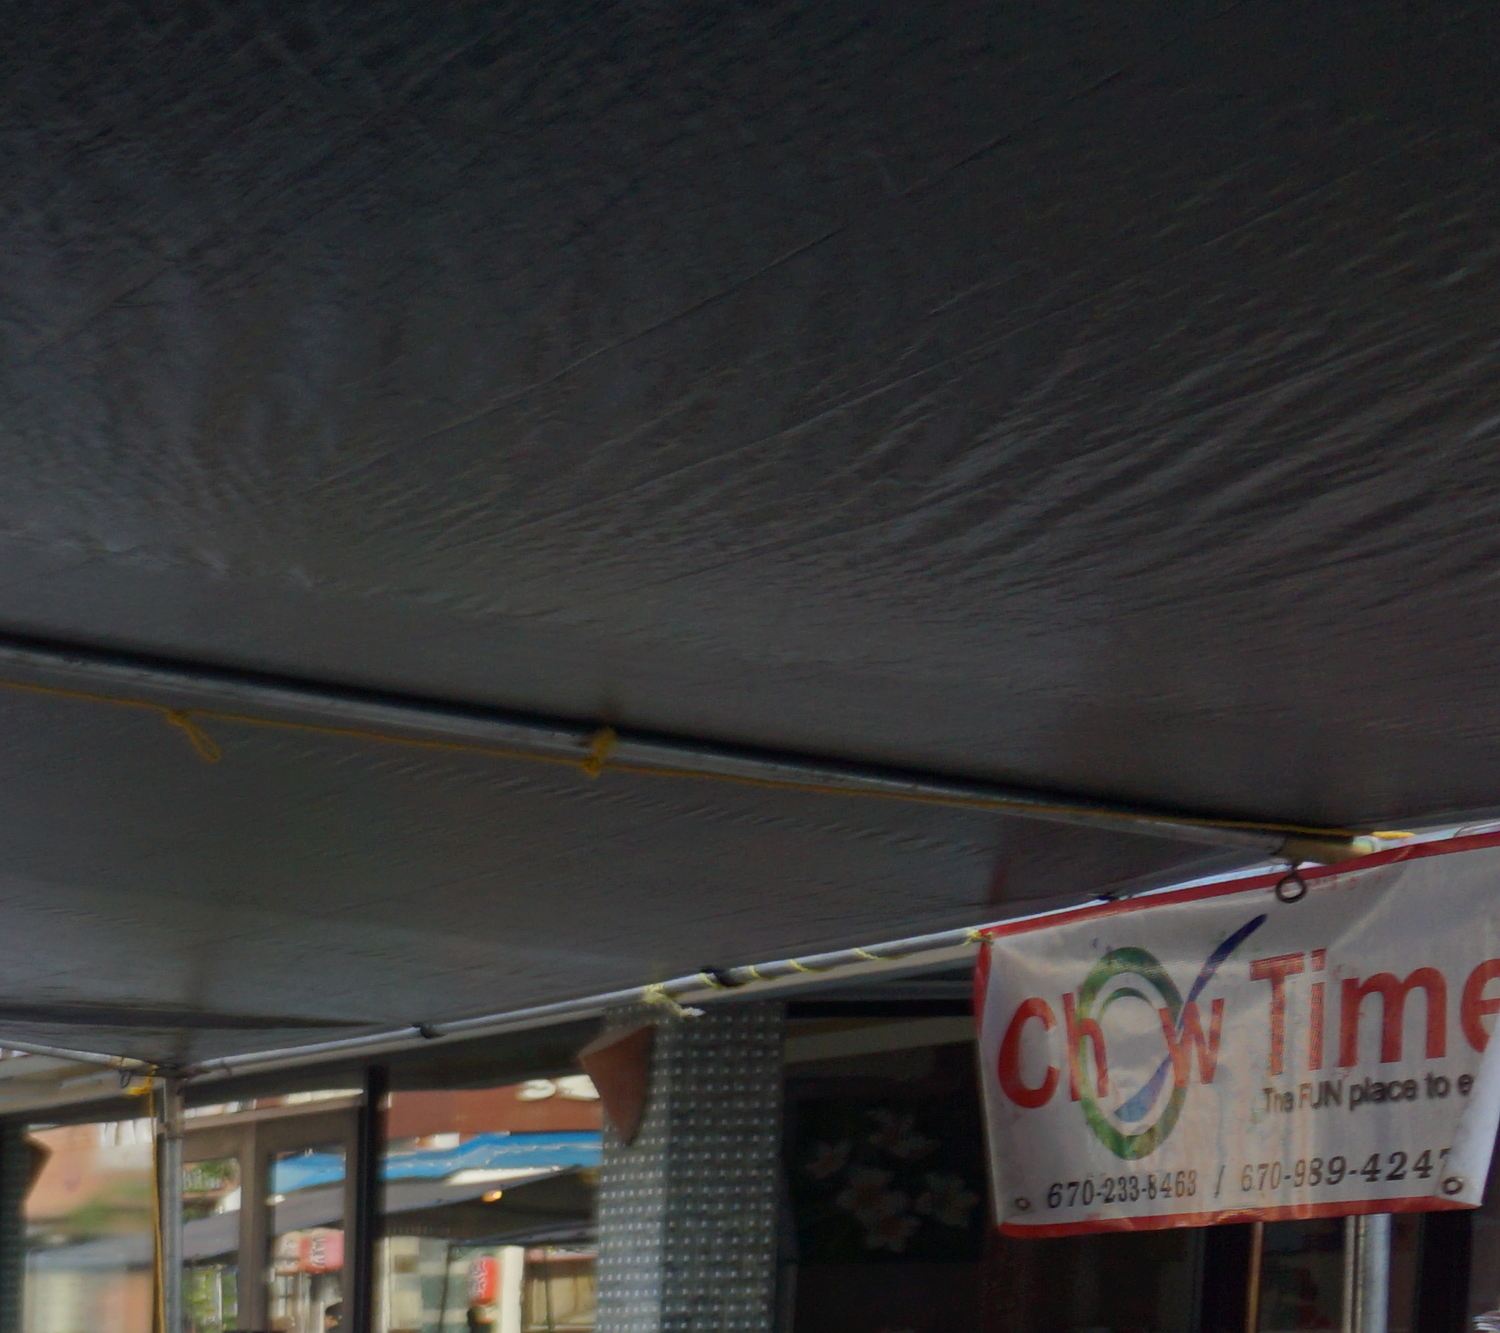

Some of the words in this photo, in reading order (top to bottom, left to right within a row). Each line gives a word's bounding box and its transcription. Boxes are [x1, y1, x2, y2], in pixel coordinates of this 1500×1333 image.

[1350, 1075, 1419, 1109] place
[1423, 1071, 1451, 1098] to
[1046, 1170, 1198, 1209] 670-233-8463
